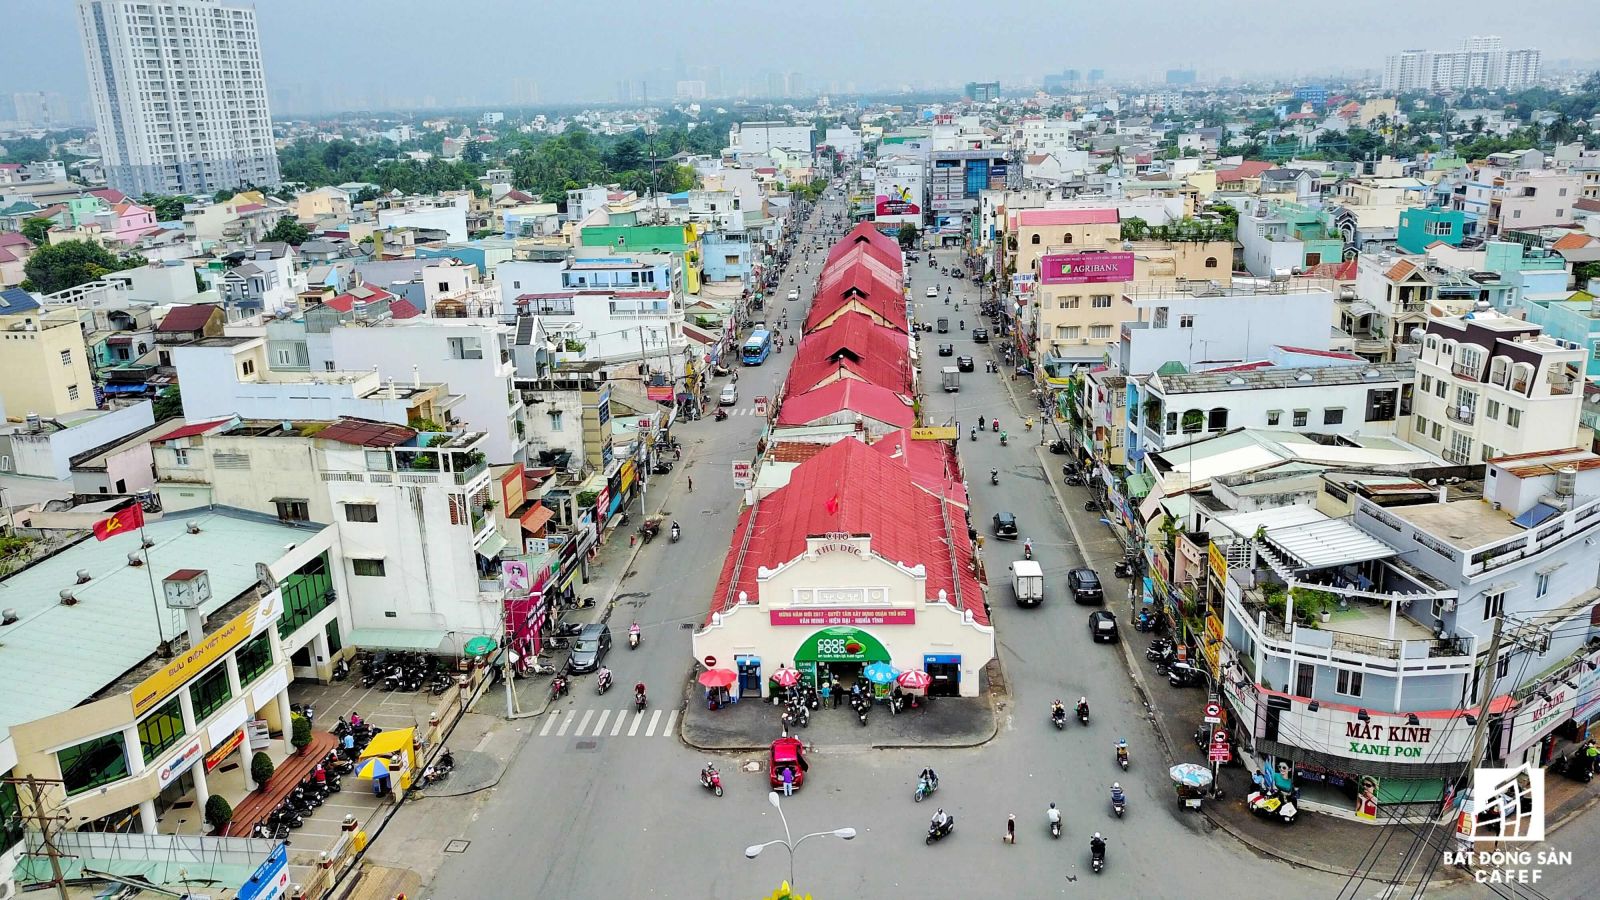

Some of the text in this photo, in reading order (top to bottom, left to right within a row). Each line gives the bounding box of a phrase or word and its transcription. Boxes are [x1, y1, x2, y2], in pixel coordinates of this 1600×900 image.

[1073, 263, 1118, 273] AGRIBANK
[1349, 742, 1422, 758] XANH PON
